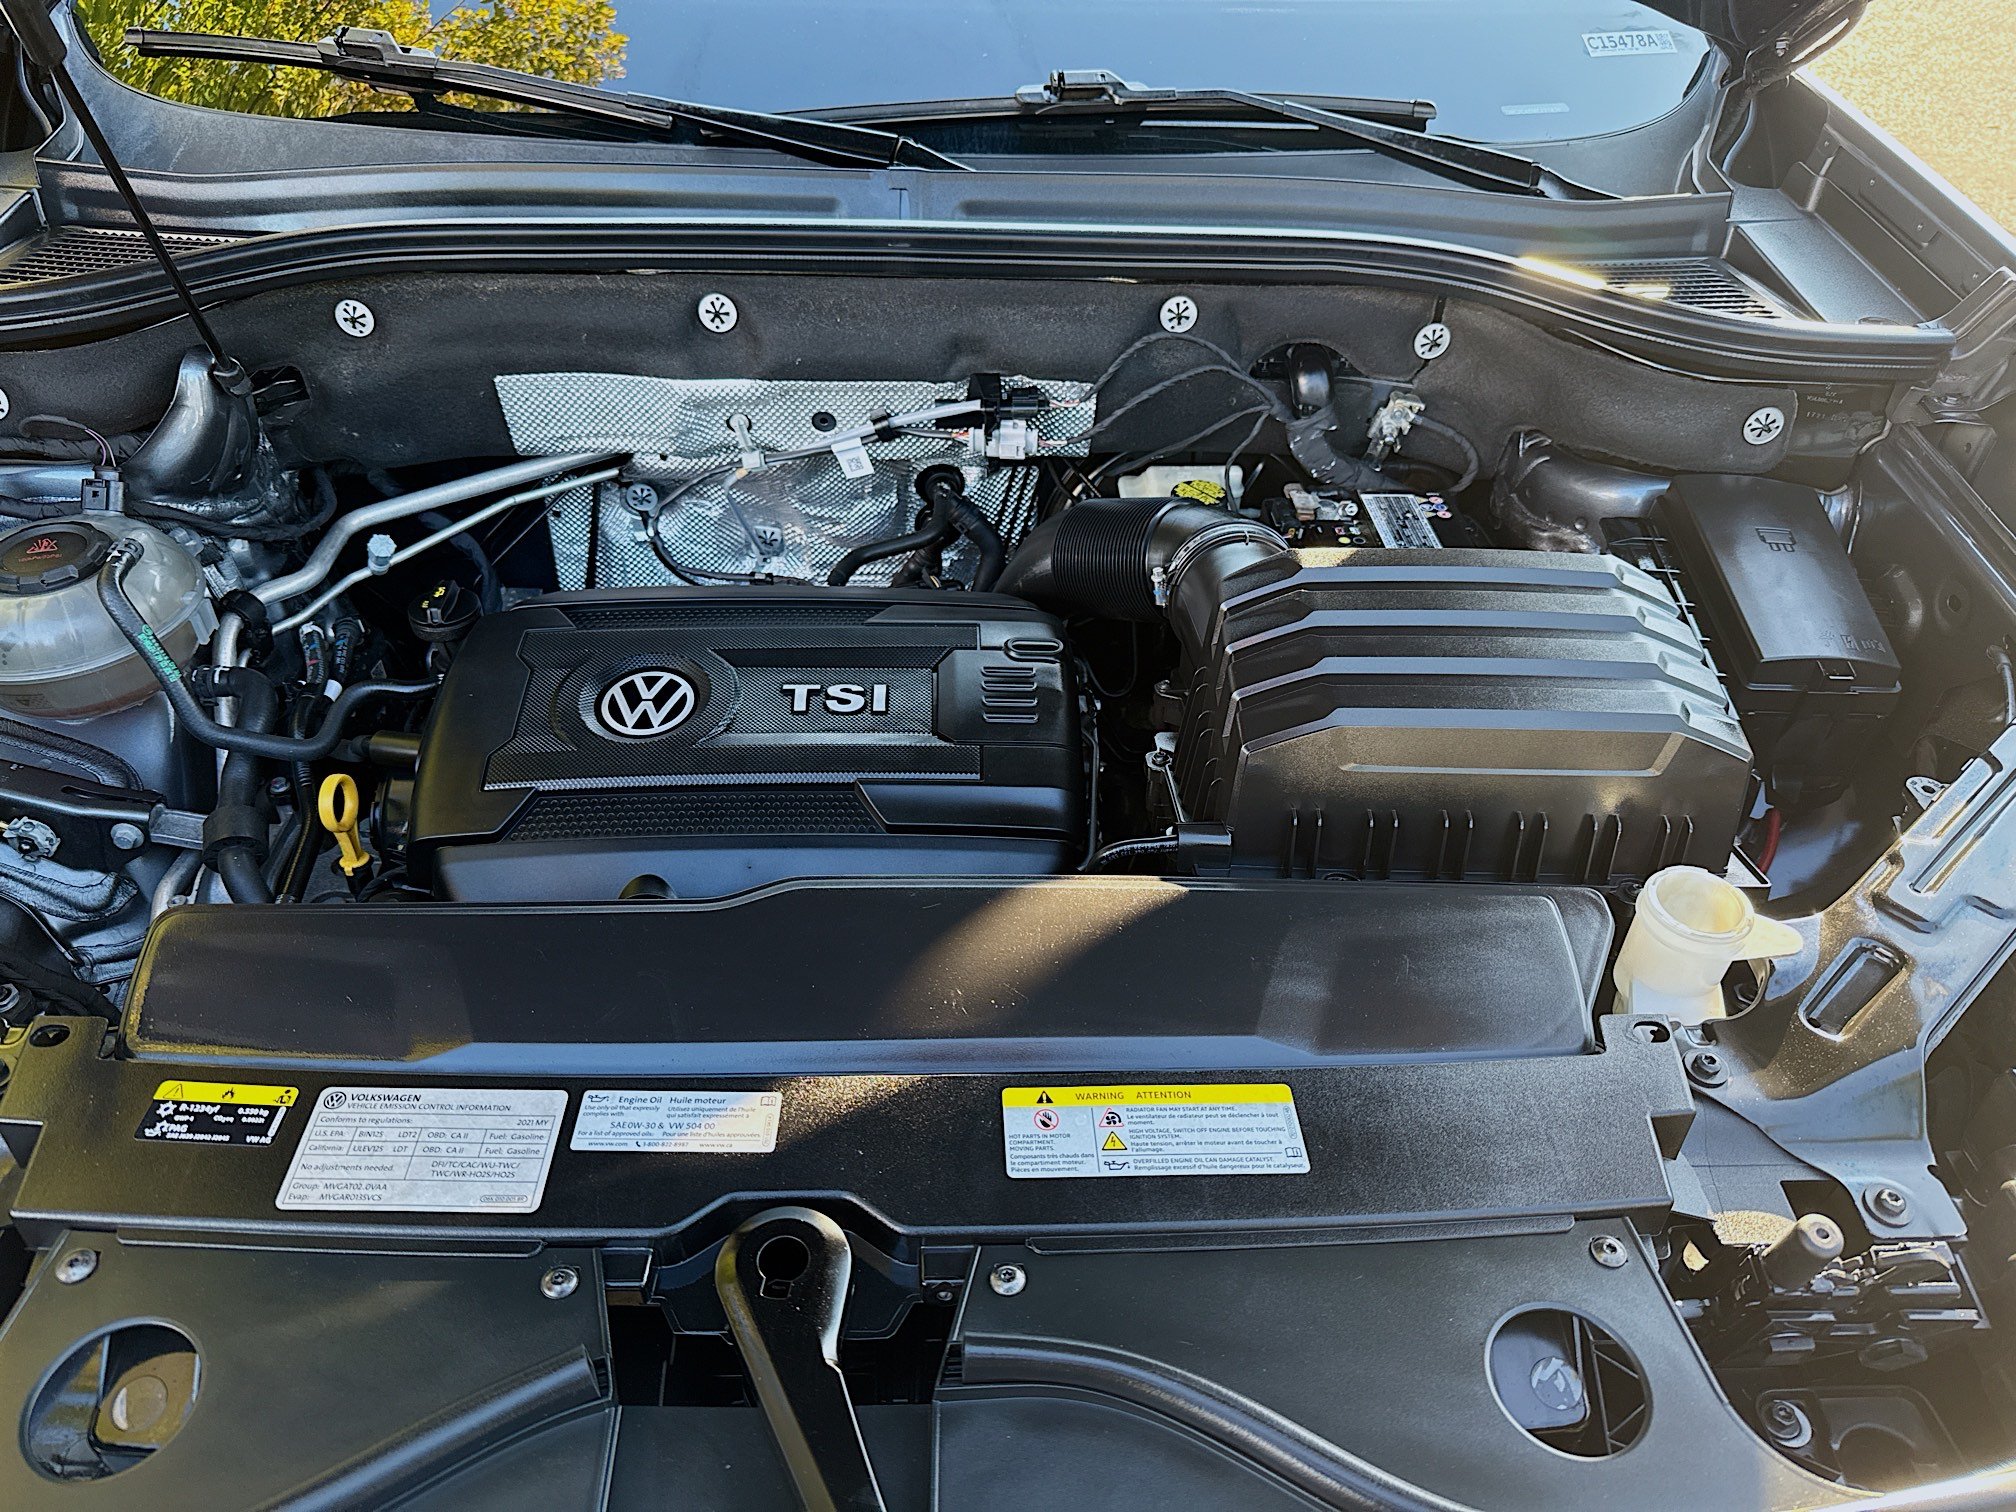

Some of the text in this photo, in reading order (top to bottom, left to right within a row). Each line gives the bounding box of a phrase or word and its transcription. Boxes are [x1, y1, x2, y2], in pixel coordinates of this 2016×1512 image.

[1586, 34, 1659, 50] C15478A
[782, 684, 888, 712] TSI
[351, 1093, 422, 1102] VOLKSWAGEN
[1075, 1091, 1192, 1101] WARNING ATTENTION
[618, 1096, 663, 1105] Engine Oil
[669, 1096, 727, 1105] Huile moteur
[418, 1103, 455, 1111] CONTROL
[320, 1115, 357, 1123] Conforms
[610, 1121, 627, 1129] SAE
[627, 1121, 657, 1129] 0W-30
[668, 1122, 685, 1130] VW
[685, 1122, 702, 1130] 504
[704, 1122, 716, 1130] 00
[427, 1131, 447, 1139] OBD:
[245, 1136, 259, 1144] VW
[446, 1146, 457, 1154] CA
[484, 1147, 503, 1155] Fuel:
[300, 1163, 313, 1171] No
[313, 1163, 363, 1172] adjustments
[292, 1183, 320, 1191] Group:
[288, 1194, 310, 1202] Evap:
